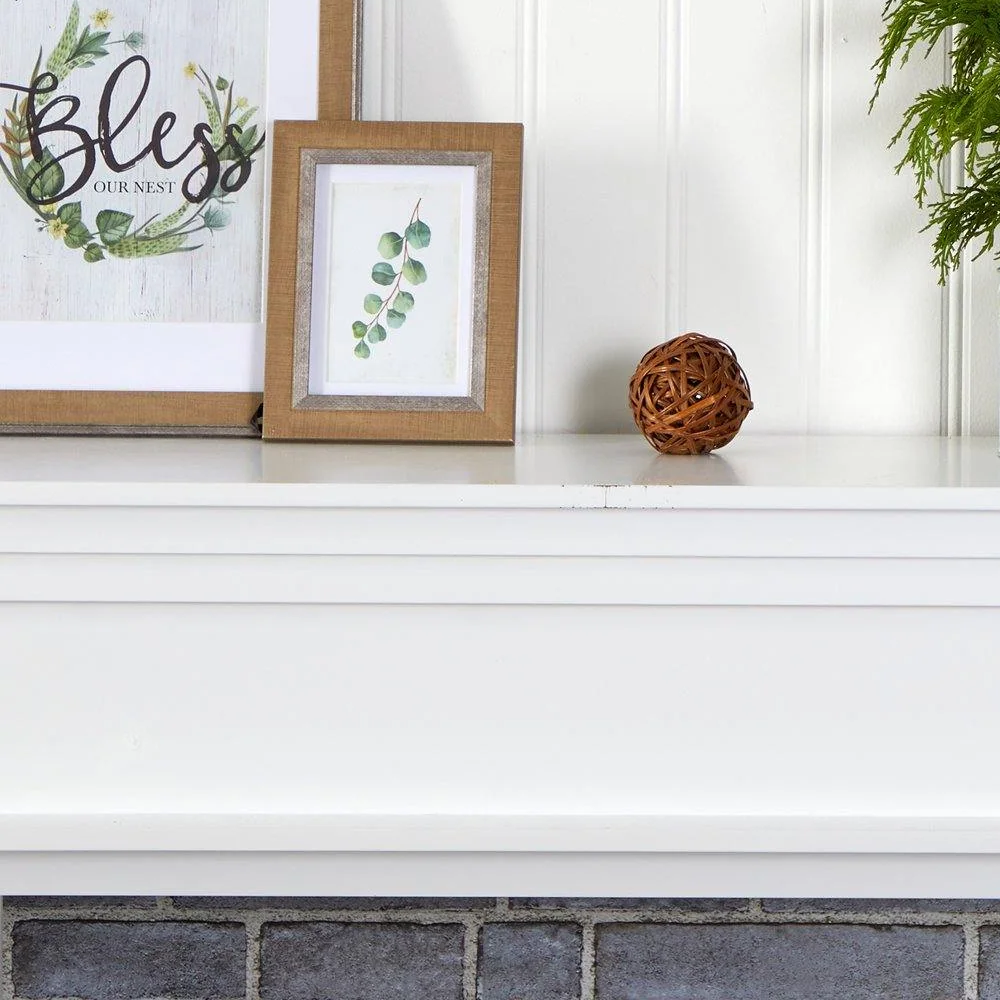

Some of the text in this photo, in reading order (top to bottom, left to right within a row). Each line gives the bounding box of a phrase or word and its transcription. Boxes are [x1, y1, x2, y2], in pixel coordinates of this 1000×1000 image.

[0, 54, 266, 206] Bless
[93, 180, 176, 194] OUR NEST
